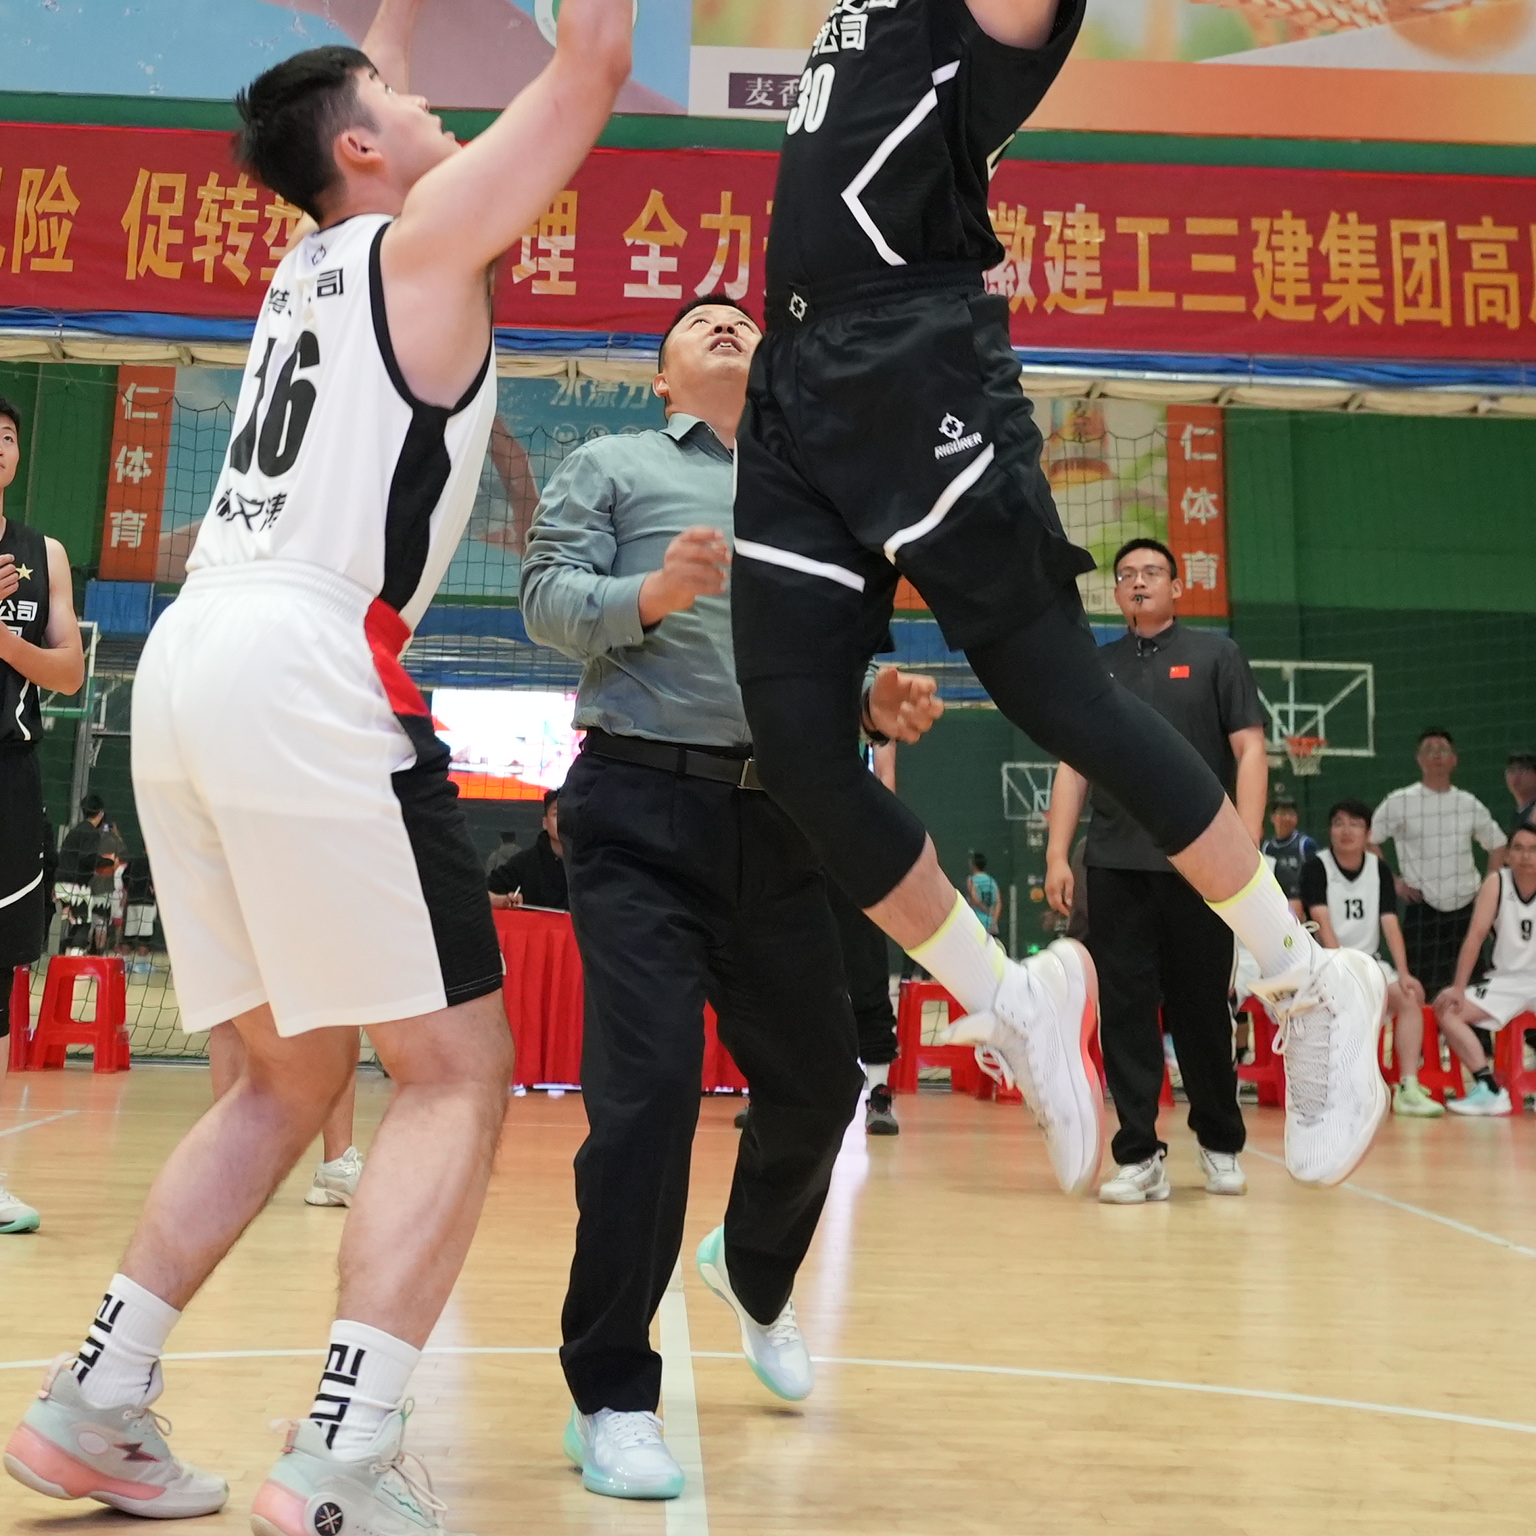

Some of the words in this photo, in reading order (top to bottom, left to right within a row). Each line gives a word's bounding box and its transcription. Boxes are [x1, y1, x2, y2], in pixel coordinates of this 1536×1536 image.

[786, 63, 836, 136] 30
[229, 330, 321, 478] 16
[109, 382, 161, 549] 仁体育
[1179, 423, 1219, 591] 仁体育
[1344, 898, 1365, 920] 13
[1520, 919, 1533, 941] 9
